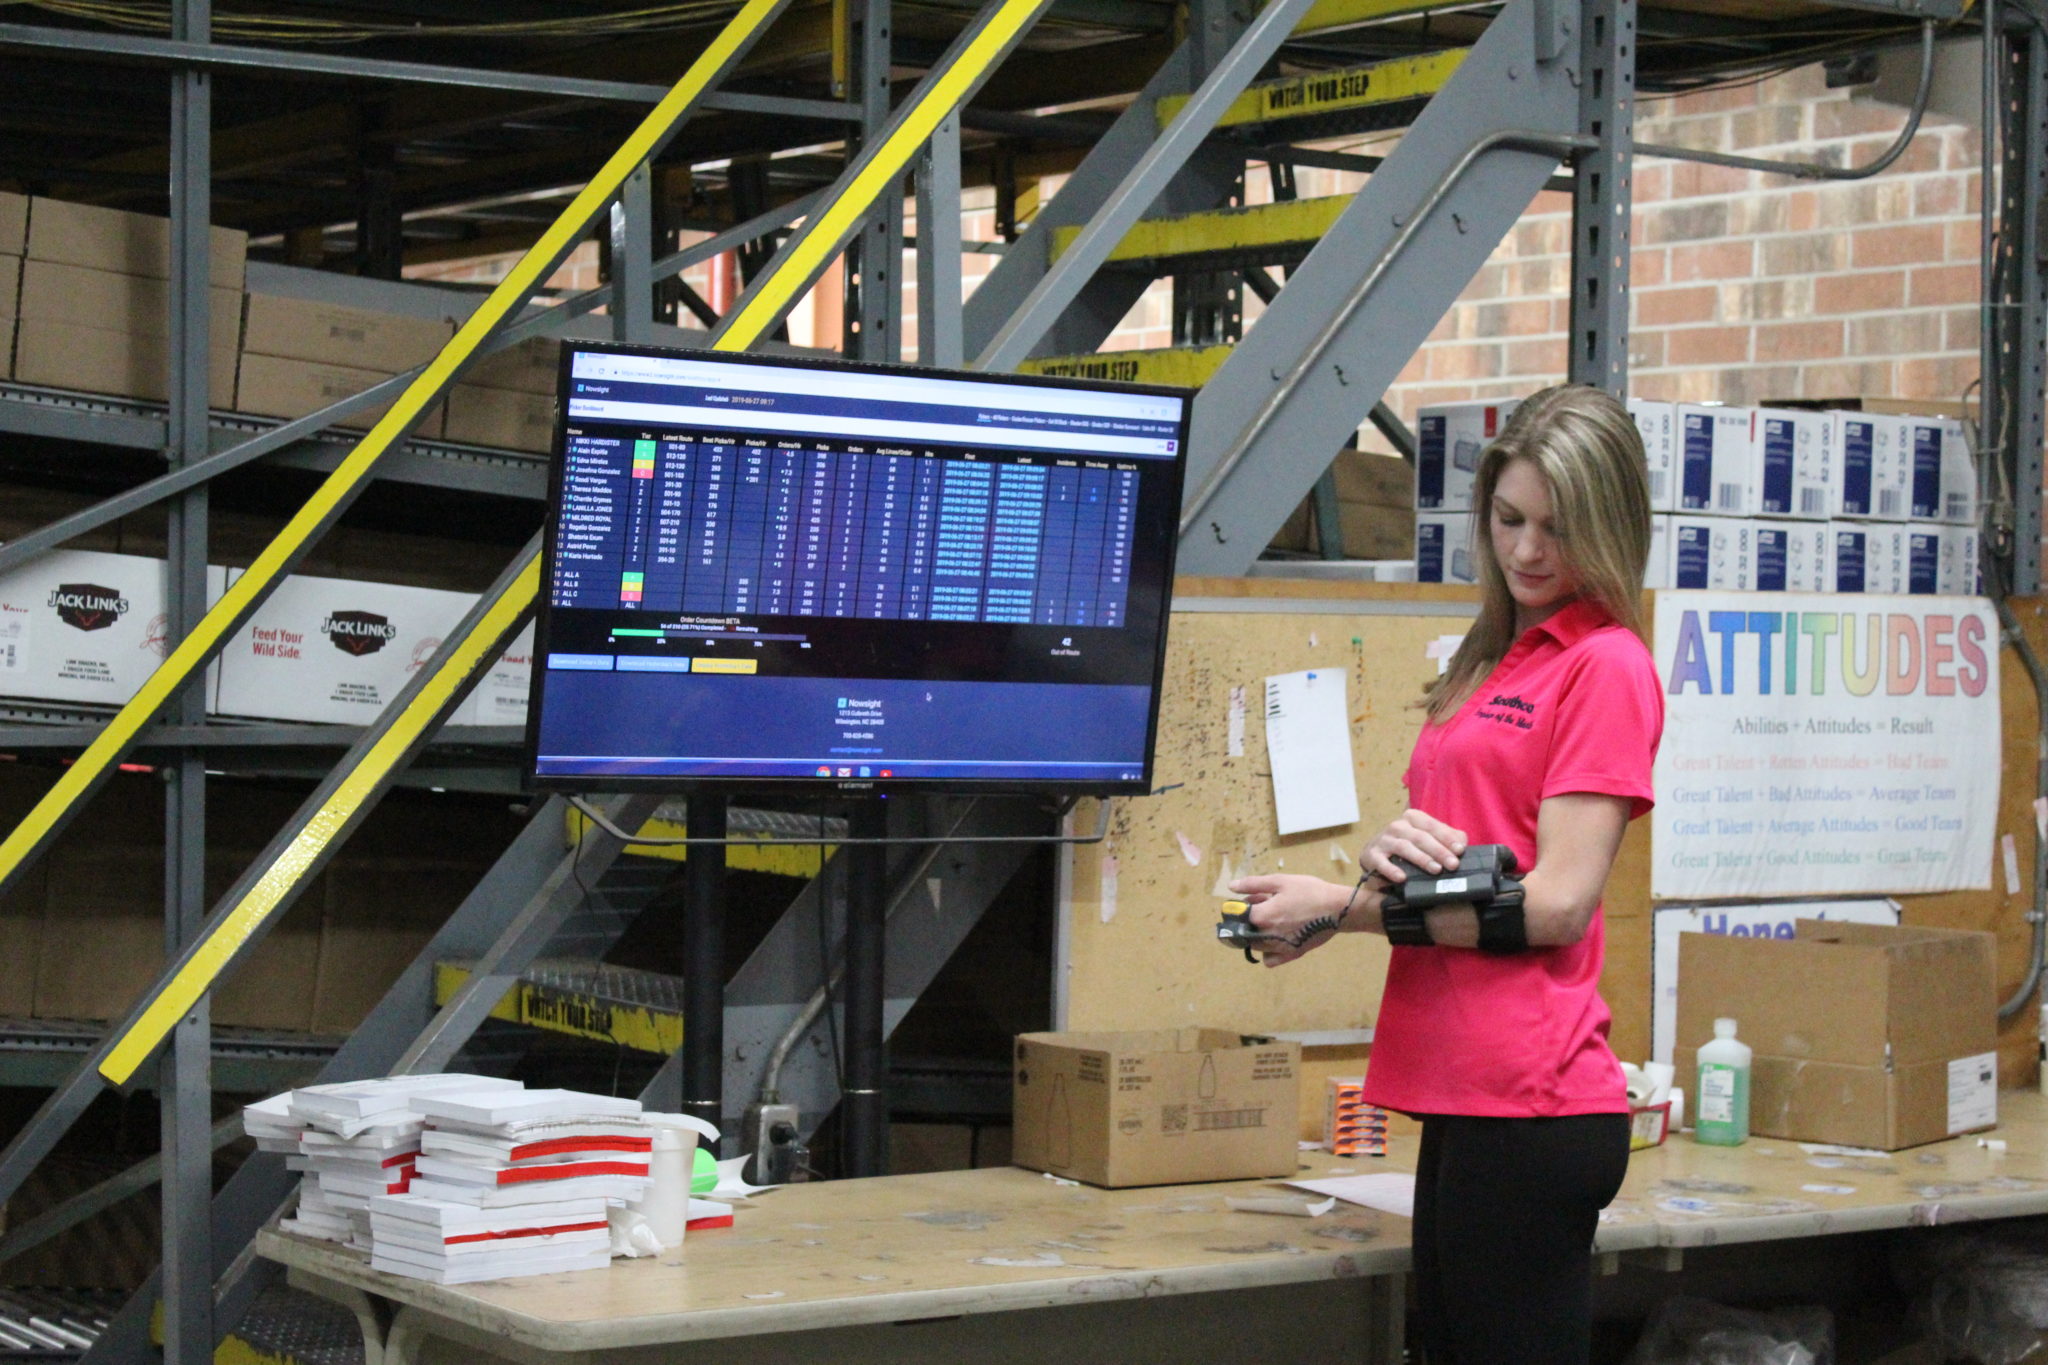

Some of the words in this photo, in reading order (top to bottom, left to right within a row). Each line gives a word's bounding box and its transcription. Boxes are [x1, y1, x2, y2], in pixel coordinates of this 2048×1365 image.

[1308, 80, 1338, 104] YOUR
[1341, 74, 1369, 98] STEP
[1111, 361, 1138, 381] STEP
[587, 524, 611, 532] Gonzalez
[48, 590, 85, 609] JACK
[321, 617, 356, 634] JACK
[695, 616, 725, 624] Countdown
[725, 617, 740, 625] BETA
[252, 626, 277, 642] Feed
[280, 629, 304, 643] Your
[252, 642, 275, 657] Wild
[1668, 610, 1988, 697] ATTITUDES
[847, 699, 881, 709] Nowsight
[1732, 717, 1789, 734] Abilities
[1805, 717, 1872, 734] Attitudes
[1890, 717, 1934, 734] Result
[1672, 754, 1710, 771] Great
[1714, 755, 1753, 771] Talent
[1809, 754, 1870, 770] Attitudes
[1887, 753, 1912, 770] Bad
[1914, 754, 1948, 770] Team
[1672, 786, 1711, 803] Great
[1715, 786, 1753, 803] Talent
[1769, 786, 1792, 802] Bad
[1794, 786, 1852, 802] Attitudes
[1869, 786, 1921, 804] Average
[1923, 785, 1957, 801] Team
[1672, 819, 1711, 836] Great
[1715, 818, 1753, 835] Talent
[1767, 818, 1814, 836] Average
[1819, 817, 1879, 833] Attitudes
[1894, 816, 1928, 832] Good
[1931, 815, 1963, 831] Team
[1671, 852, 1710, 869] Great
[1713, 851, 1752, 868] Talent
[1766, 850, 1800, 866] Good
[1802, 849, 1862, 865] Attitudes
[1877, 849, 1912, 865] Great
[1914, 847, 1948, 863] Team
